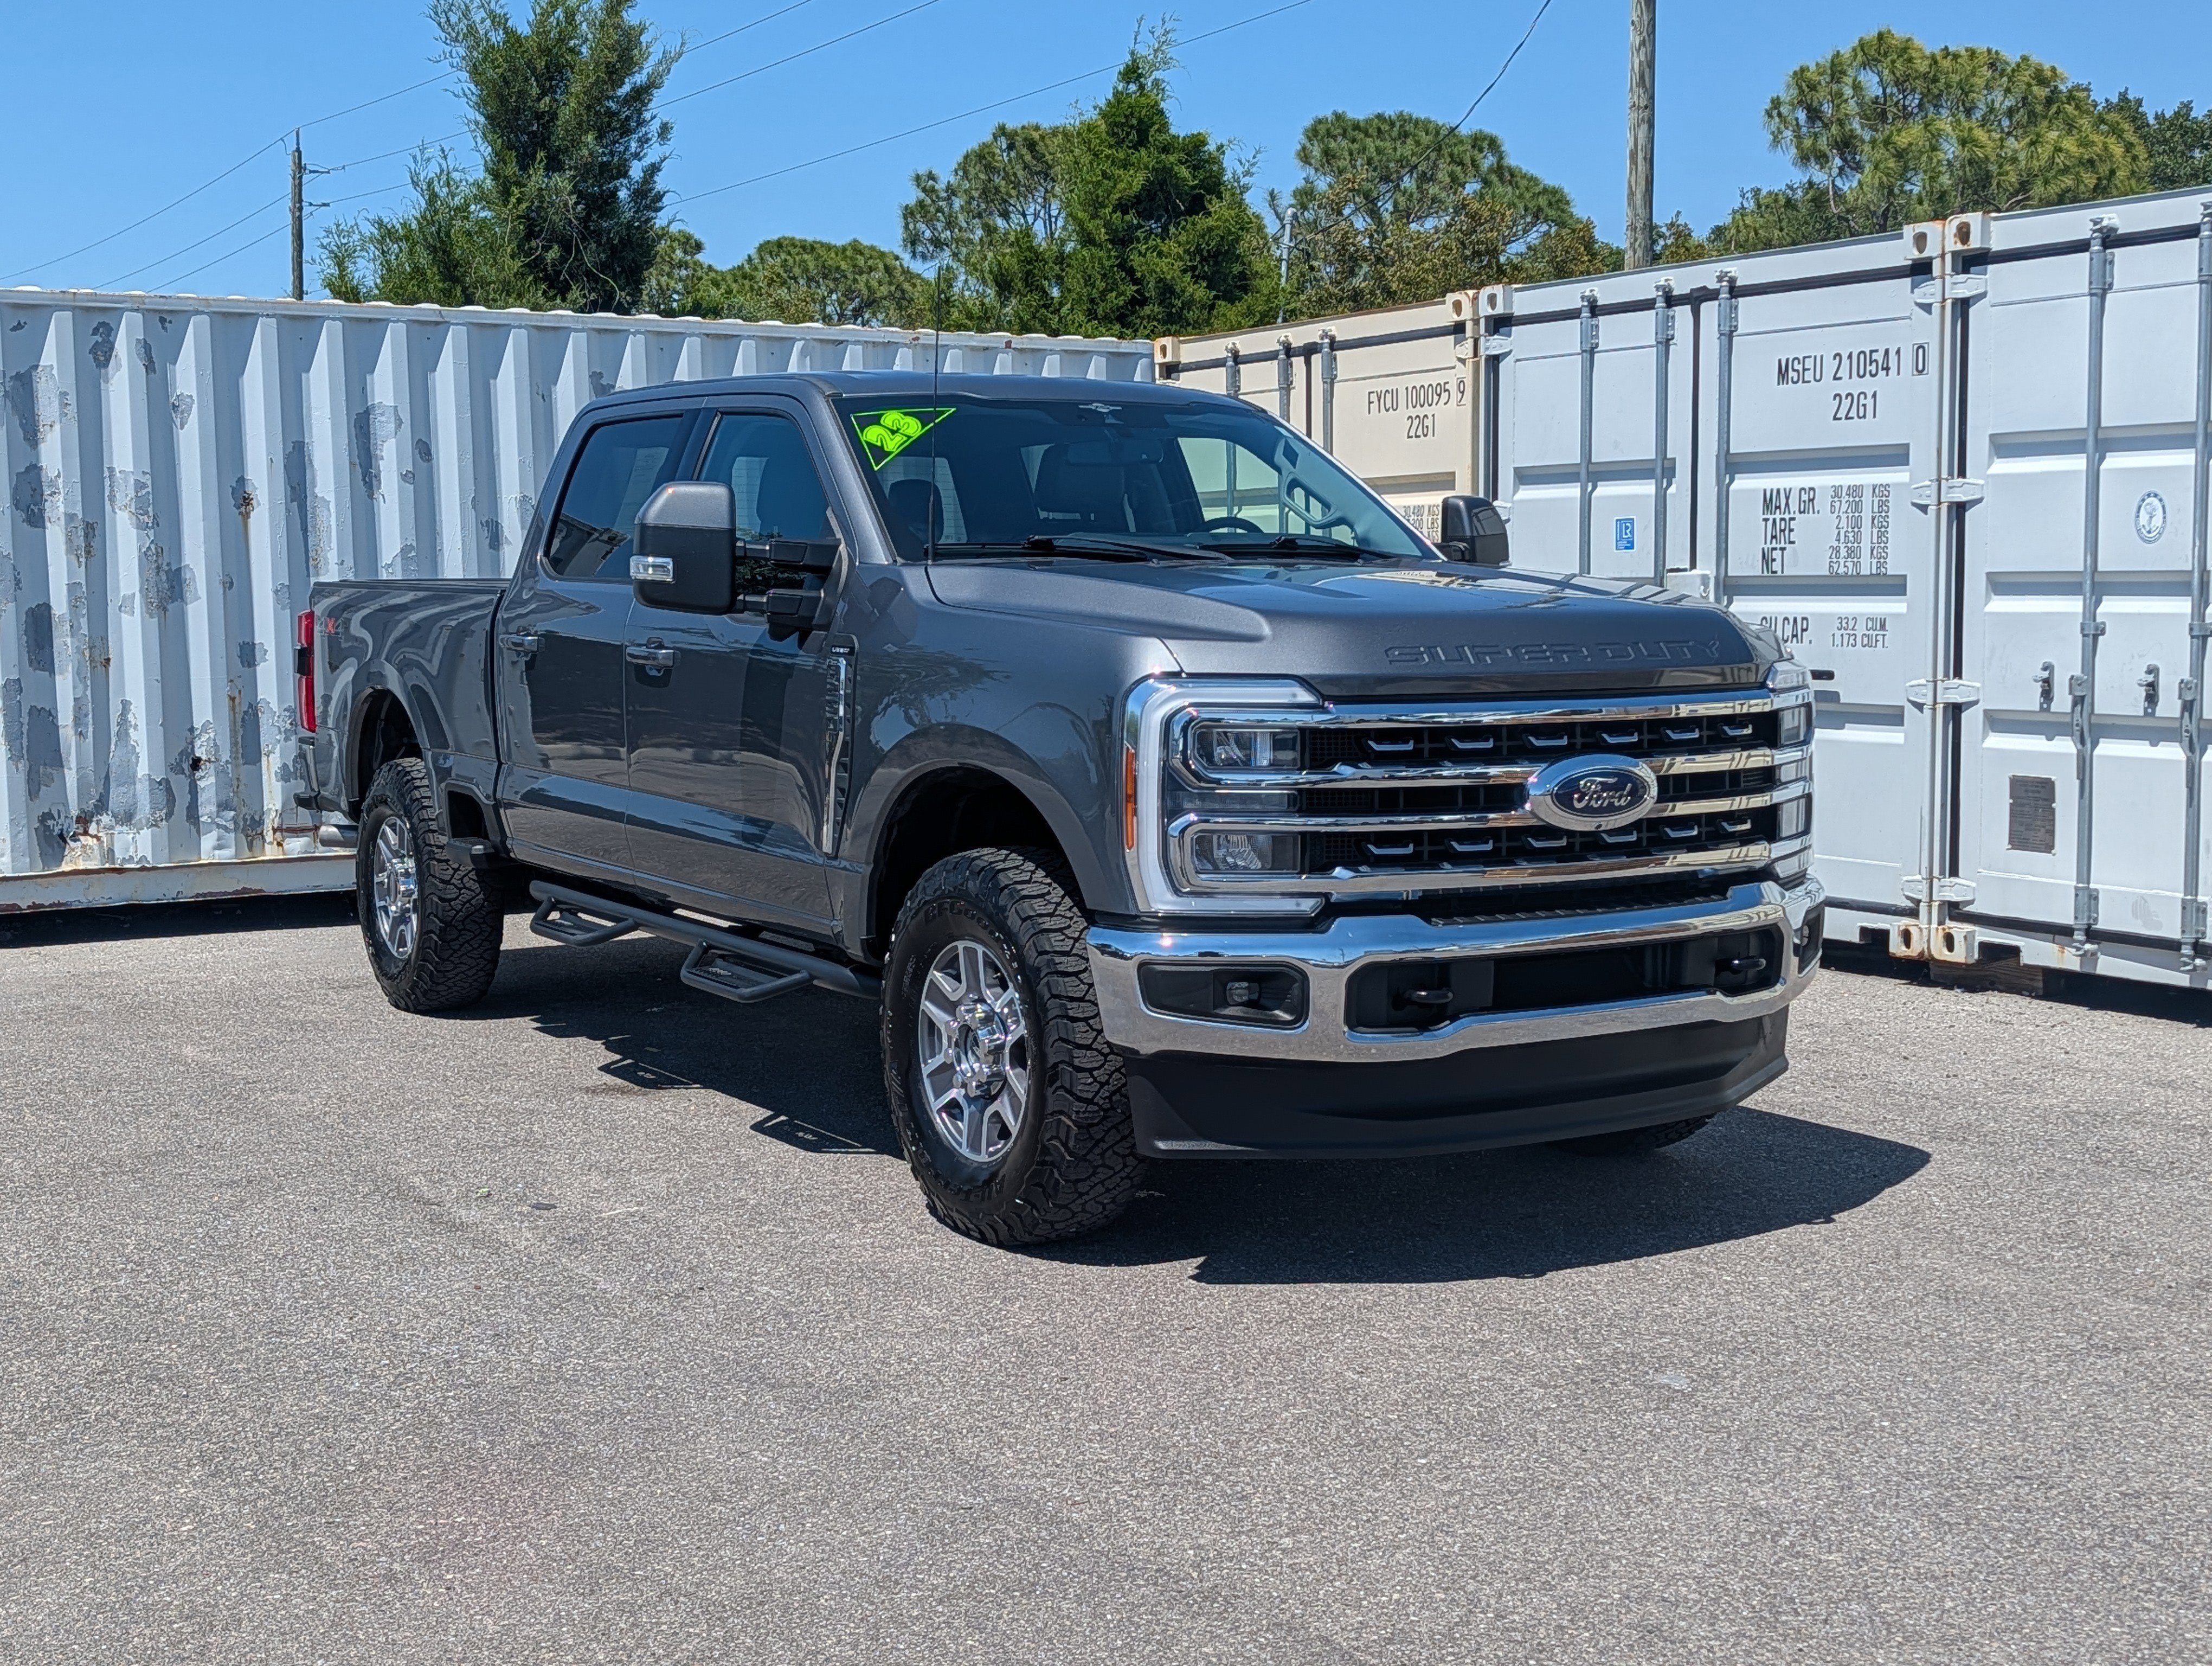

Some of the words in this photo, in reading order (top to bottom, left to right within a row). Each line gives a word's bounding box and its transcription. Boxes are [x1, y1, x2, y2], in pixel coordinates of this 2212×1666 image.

[1777, 354, 1823, 386] MSEU
[1832, 347, 1901, 381] 210541
[1915, 345, 1925, 373] 0
[1368, 388, 1399, 415] FYCU
[1405, 381, 1451, 410] 100095
[1458, 379, 1465, 403] 9
[1832, 390, 1877, 421] 22G1
[863, 411, 922, 452] 23
[1406, 414, 1436, 439] 22G1
[1830, 484, 1864, 499] 30.480
[1872, 483, 1891, 498] KGS
[1427, 504, 1439, 517] KGS
[1830, 499, 1863, 514] 67.200
[1871, 499, 1890, 514] LBS
[1427, 517, 1439, 529] LBS
[1762, 517, 1796, 545] TARE
[1836, 515, 1863, 529] 2.100
[1871, 515, 1889, 529] KGS
[1835, 530, 1862, 544] 4.630
[1870, 530, 1889, 544] LBS
[1761, 547, 1787, 574] NET
[1828, 546, 1862, 560] 28.380
[1870, 546, 1888, 560] KGS
[1828, 560, 1861, 575] 62.570
[1870, 560, 1888, 575] LBS
[1837, 616, 1857, 631] 33.2
[1385, 643, 1591, 666] SUPER
[1598, 639, 1720, 661] DUTY
[1831, 633, 1857, 648] 1.173
[1573, 777, 1632, 808] Ford
